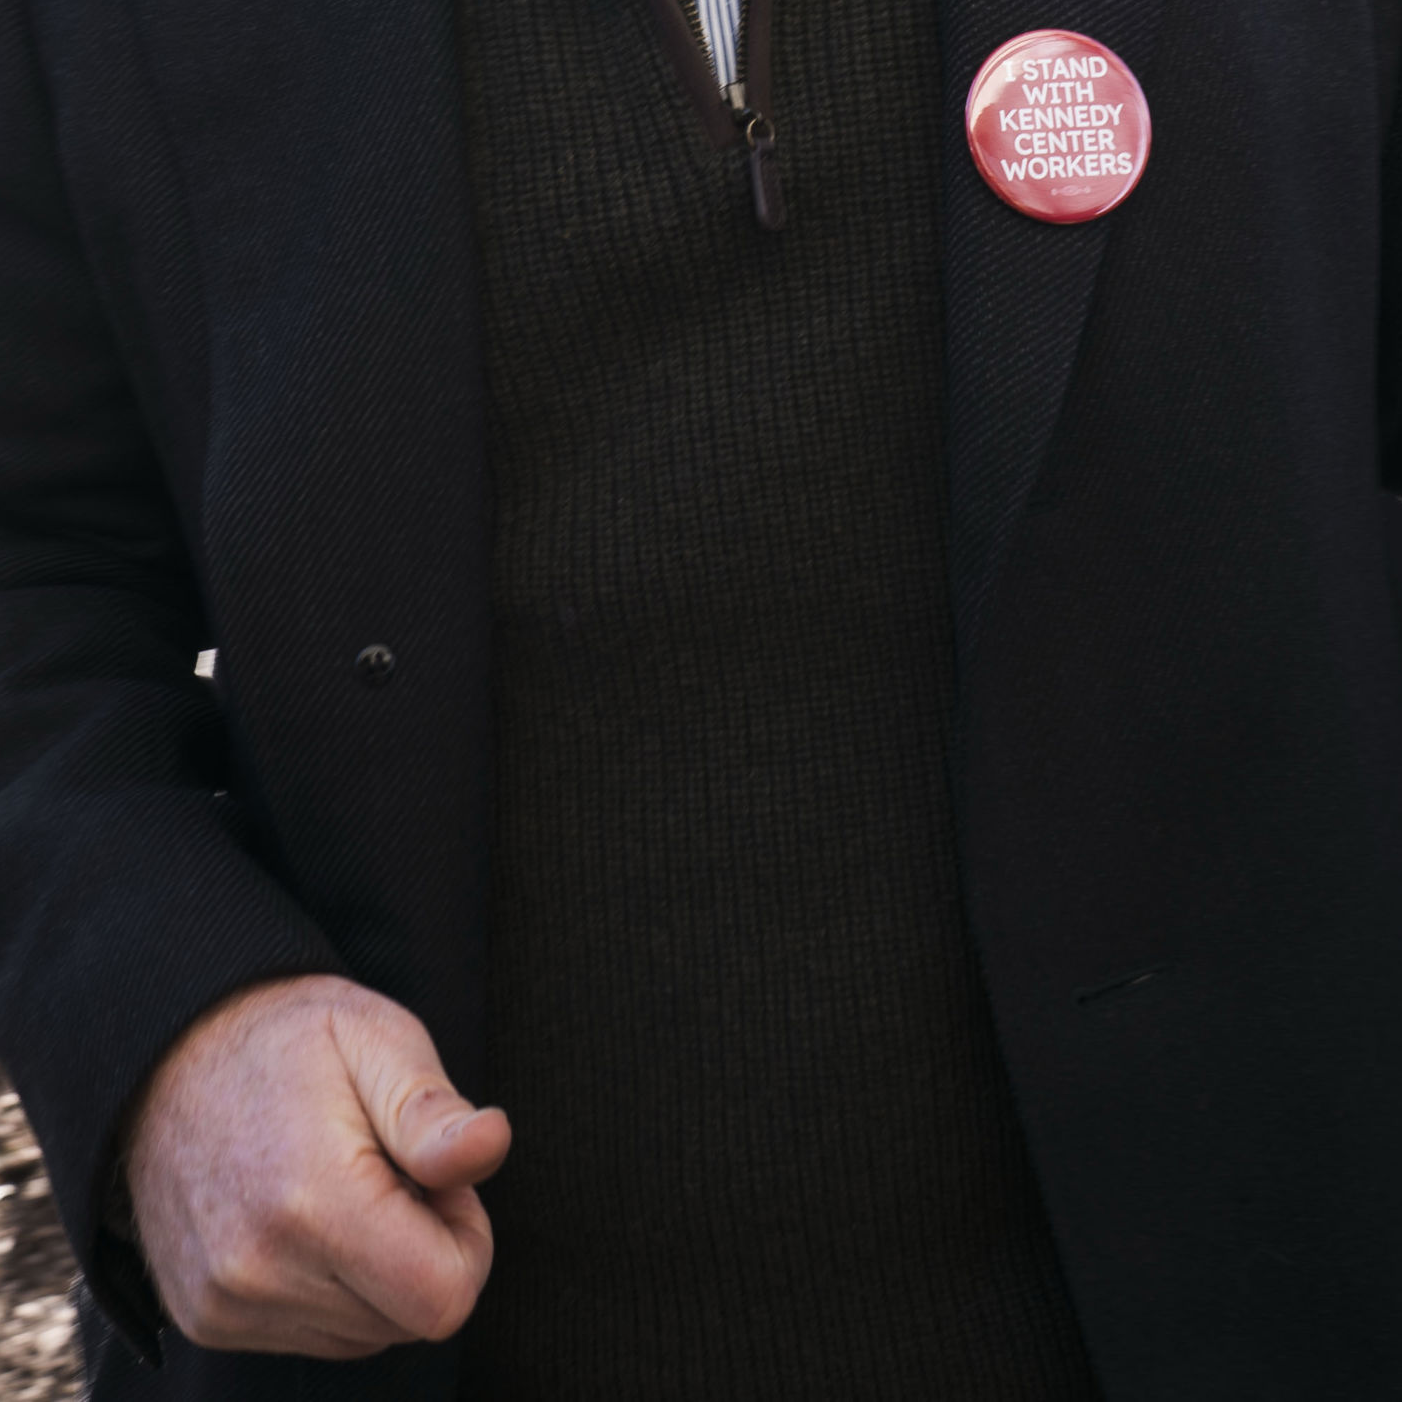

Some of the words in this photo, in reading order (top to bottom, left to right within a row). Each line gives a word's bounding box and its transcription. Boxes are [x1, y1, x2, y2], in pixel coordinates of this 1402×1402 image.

[1003, 60, 1016, 82] I
[1022, 56, 1108, 81] STAND
[1022, 81, 1094, 105] WITH
[999, 103, 1124, 132] KENNEDY
[1014, 129, 1116, 156] CENTER
[1000, 152, 1132, 182] WORKERS
